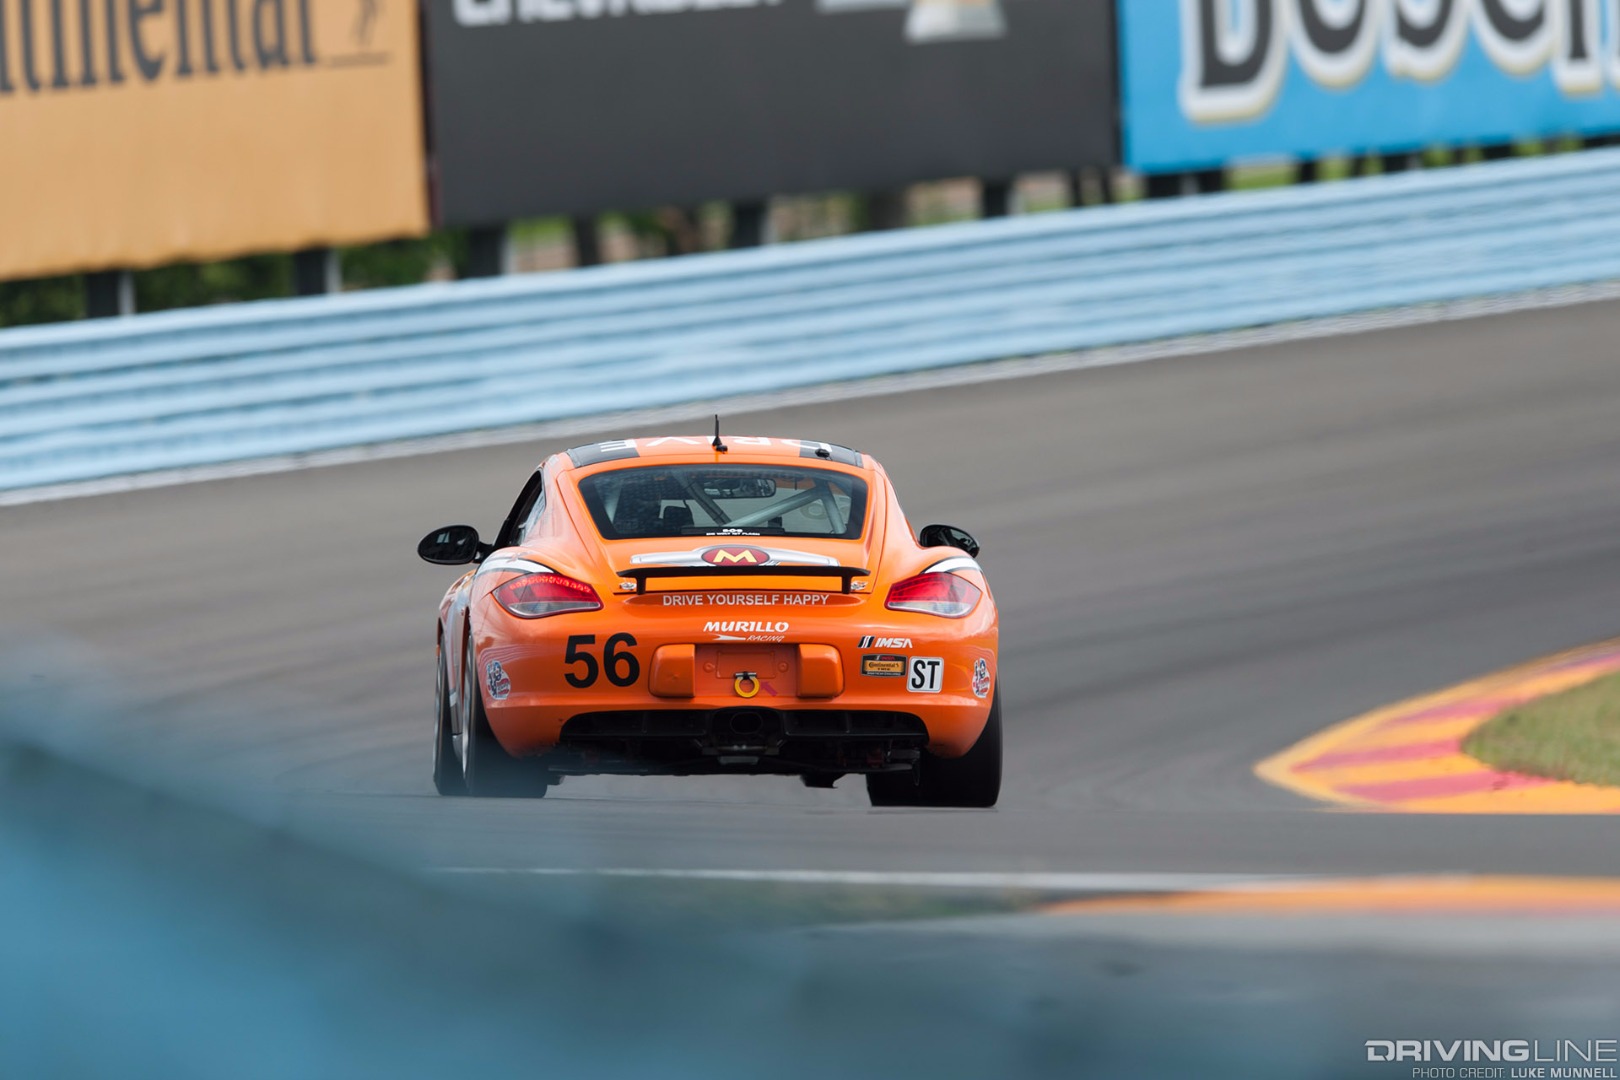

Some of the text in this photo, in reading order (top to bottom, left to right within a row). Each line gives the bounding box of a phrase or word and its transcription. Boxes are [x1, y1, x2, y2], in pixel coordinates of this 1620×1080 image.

[712, 549, 758, 563] M
[663, 594, 830, 606] DRIVE YOURSELF HAPPY
[703, 621, 789, 633] MURILLO
[747, 634, 785, 643] RACING
[874, 637, 913, 649] IMSA
[564, 632, 640, 688] 56
[911, 659, 940, 689] ST
